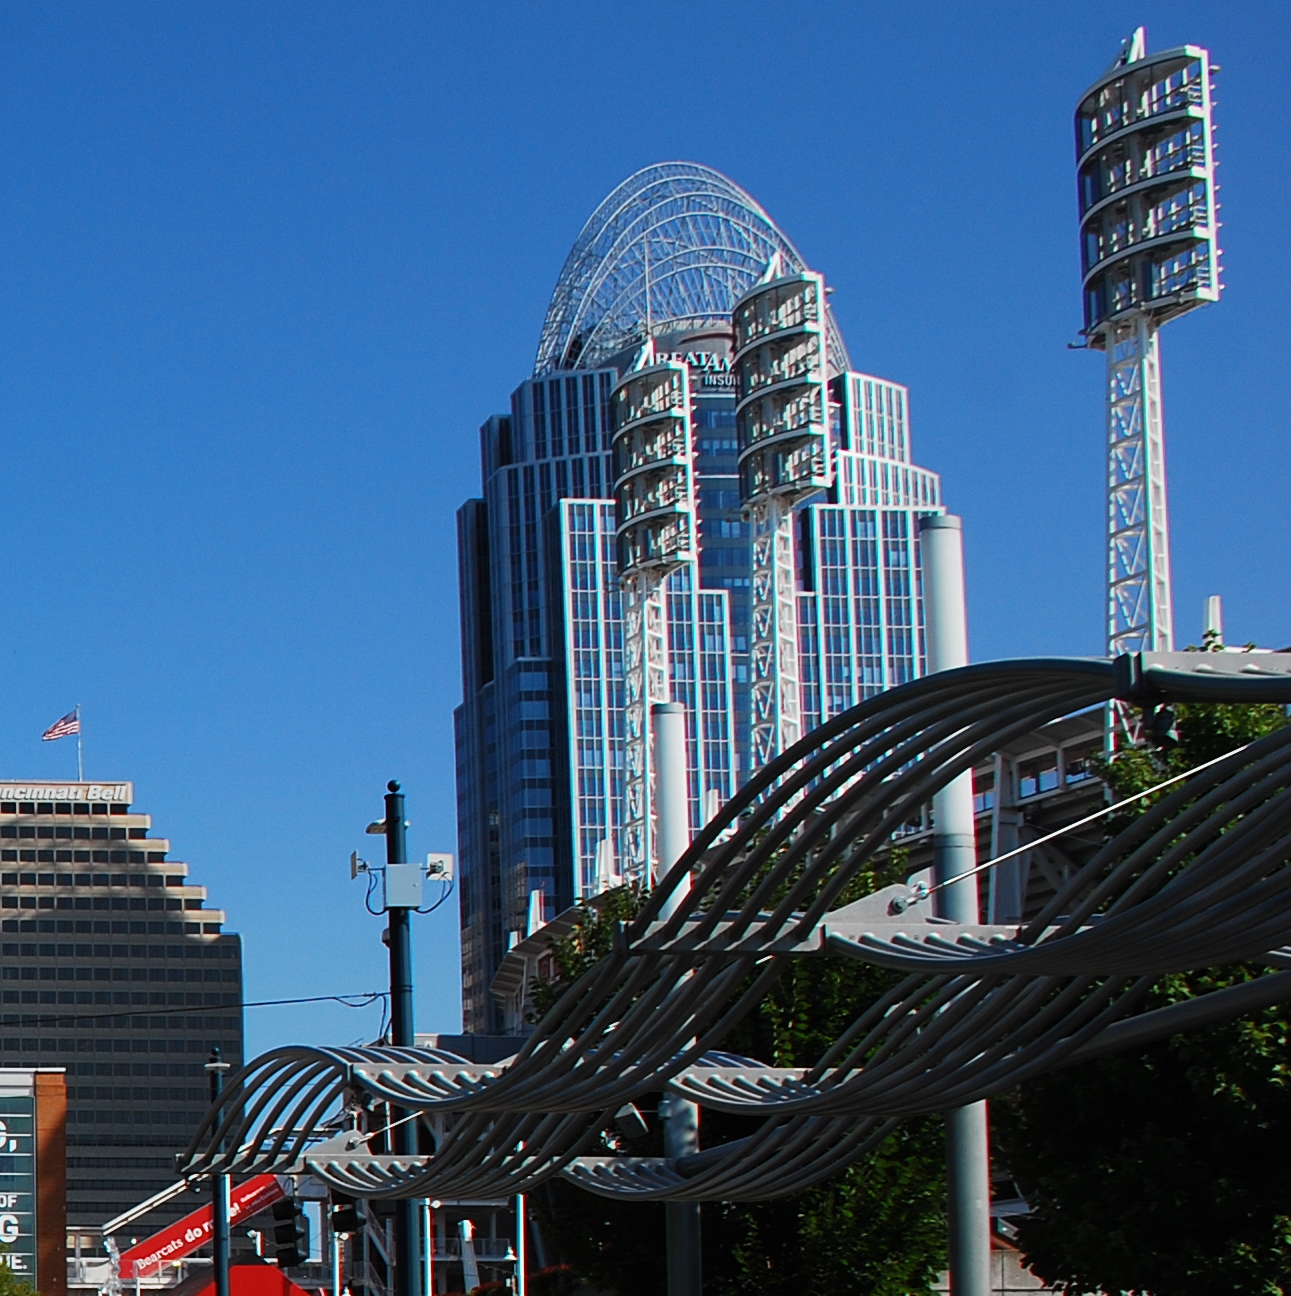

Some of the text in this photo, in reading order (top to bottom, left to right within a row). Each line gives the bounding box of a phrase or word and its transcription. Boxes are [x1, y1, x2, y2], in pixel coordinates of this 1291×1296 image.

[87, 785, 127, 800] Bell
[135, 1238, 184, 1270] Bearcats
[184, 1226, 203, 1243] do
